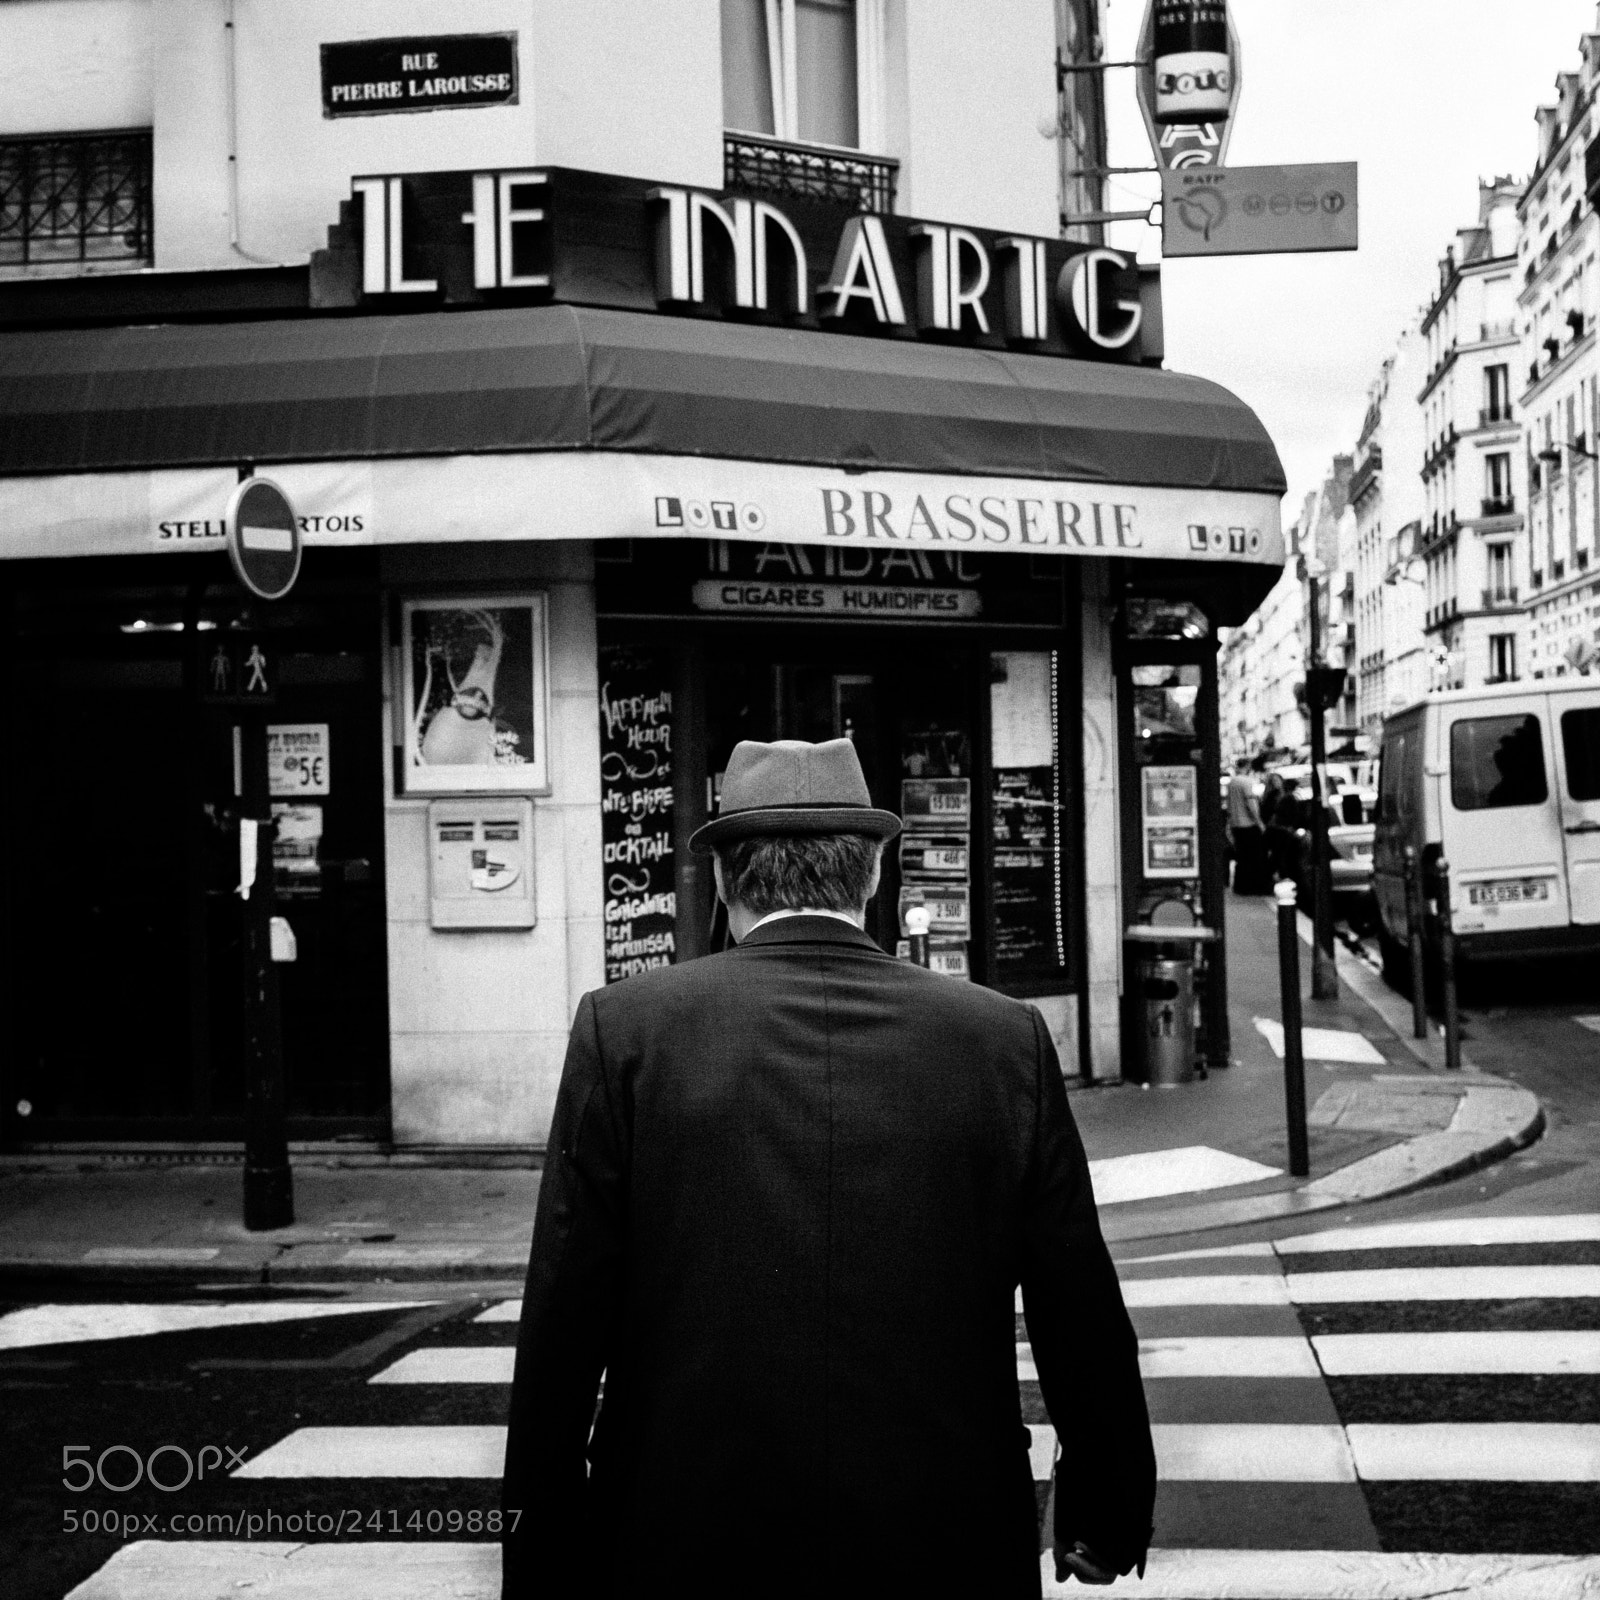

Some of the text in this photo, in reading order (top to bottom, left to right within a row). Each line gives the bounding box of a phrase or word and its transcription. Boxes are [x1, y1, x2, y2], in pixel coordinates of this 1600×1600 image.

[402, 52, 438, 71] RUE
[331, 73, 511, 102] PIERRE LAROUSSE
[353, 172, 551, 294] LE
[297, 515, 365, 533] RTOIS
[655, 488, 1264, 555] LOTO BRASSERIE LOTO
[721, 585, 959, 613] CIGARES HUMIDIFIES
[300, 757, 324, 787] 5€
[603, 831, 674, 865] OCKTAiL
